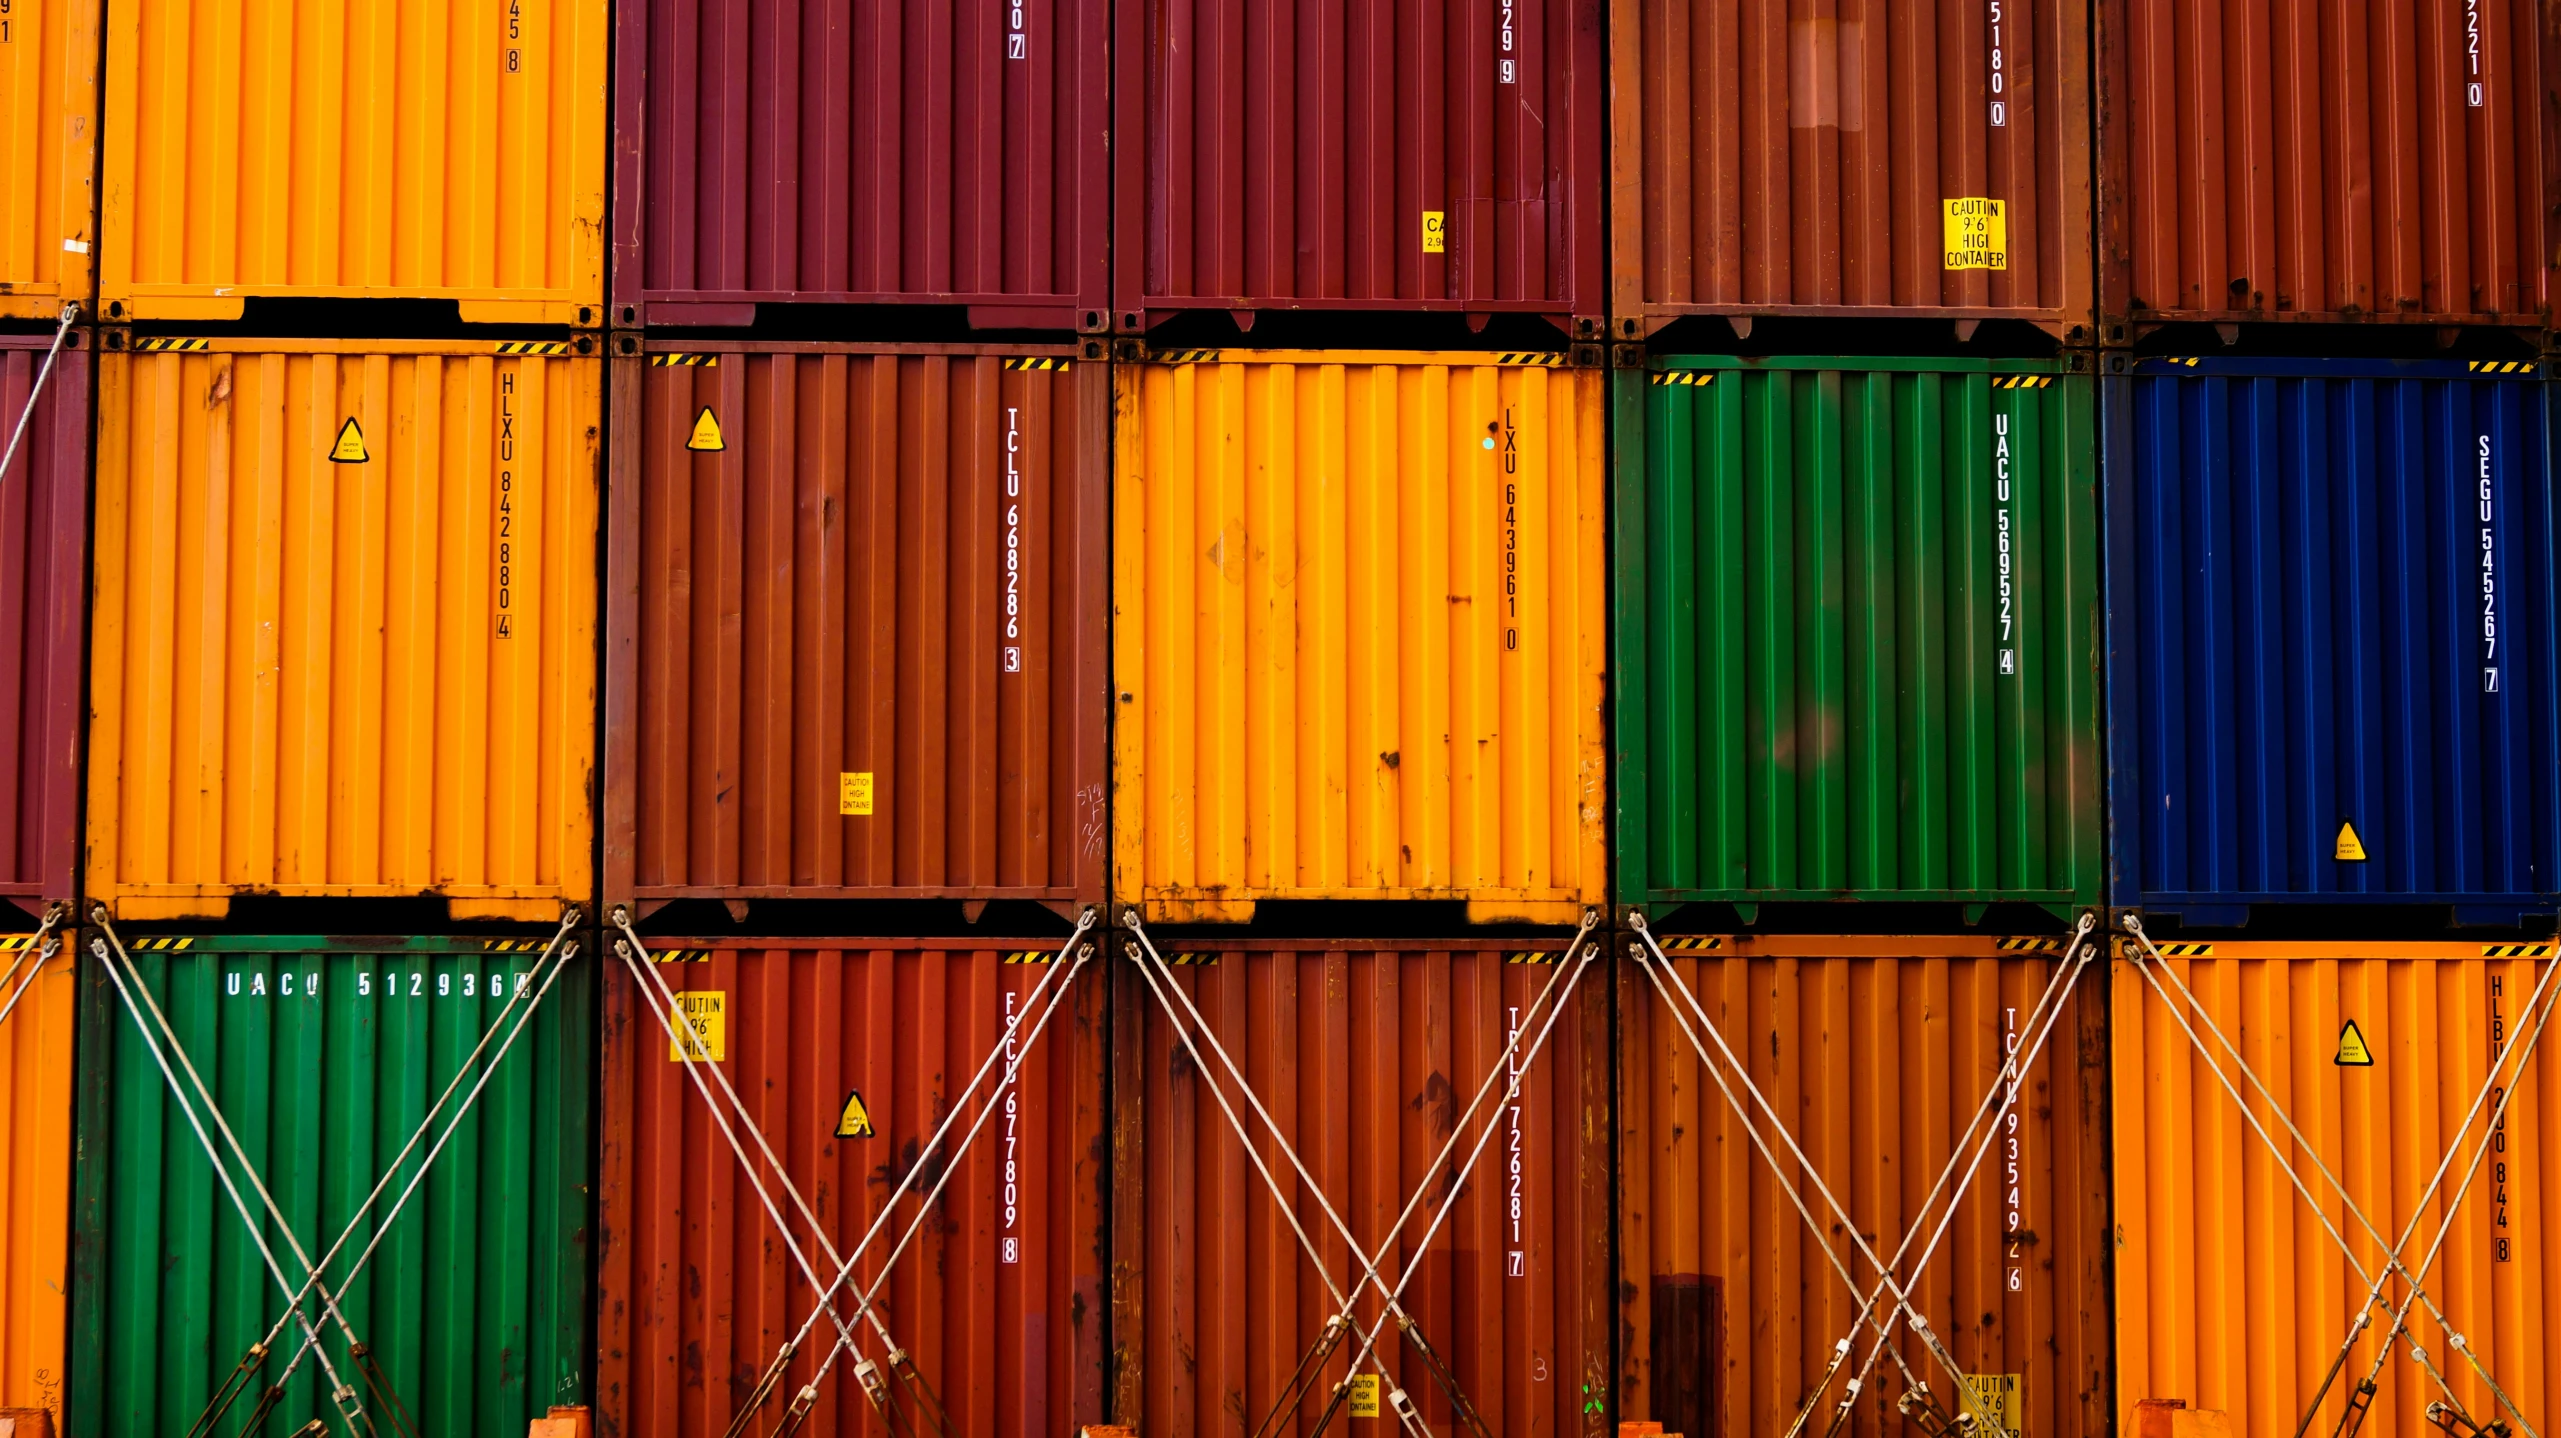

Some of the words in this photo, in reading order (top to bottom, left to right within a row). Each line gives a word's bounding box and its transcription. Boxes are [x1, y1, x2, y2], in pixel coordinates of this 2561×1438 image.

[509, 0, 520, 39] 45
[1010, 34, 1023, 58] 7
[1990, 1, 2003, 94] 5180
[508, 50, 518, 72] 8
[1501, 61, 1514, 82] 9
[2469, 84, 2481, 105] 0
[1992, 102, 2003, 125] 0
[501, 373, 513, 461] HLXU
[1007, 408, 1018, 497] TCLU
[1504, 408, 1516, 474] LXU
[1996, 414, 2009, 501] UACU
[2479, 435, 2492, 522] SEGU
[1506, 484, 1516, 618] 643961
[1006, 504, 1018, 638] 668286
[1998, 509, 2011, 641] 569527
[2482, 528, 2495, 659] 545267
[498, 616, 509, 637] 4
[1506, 628, 1516, 651] 0
[1006, 648, 1018, 671] 3
[2001, 650, 2012, 673] 4
[2486, 669, 2497, 691] 7
[848, 789, 865, 798] HIGH
[227, 972, 319, 996] UACU
[358, 972, 503, 996] 512936
[2491, 975, 2505, 1063] HLBU
[1004, 1091, 1016, 1228] 677809
[1509, 1106, 1521, 1242] 726281
[2007, 1113, 2020, 1258] 935492
[1004, 1239, 1016, 1262] 8
[2497, 1238, 2508, 1261] 8
[1510, 1253, 1522, 1276] 7
[2009, 1268, 2020, 1291] 6
[1533, 1357, 1548, 1382] 3
[1355, 1391, 1370, 1400] HIGH
